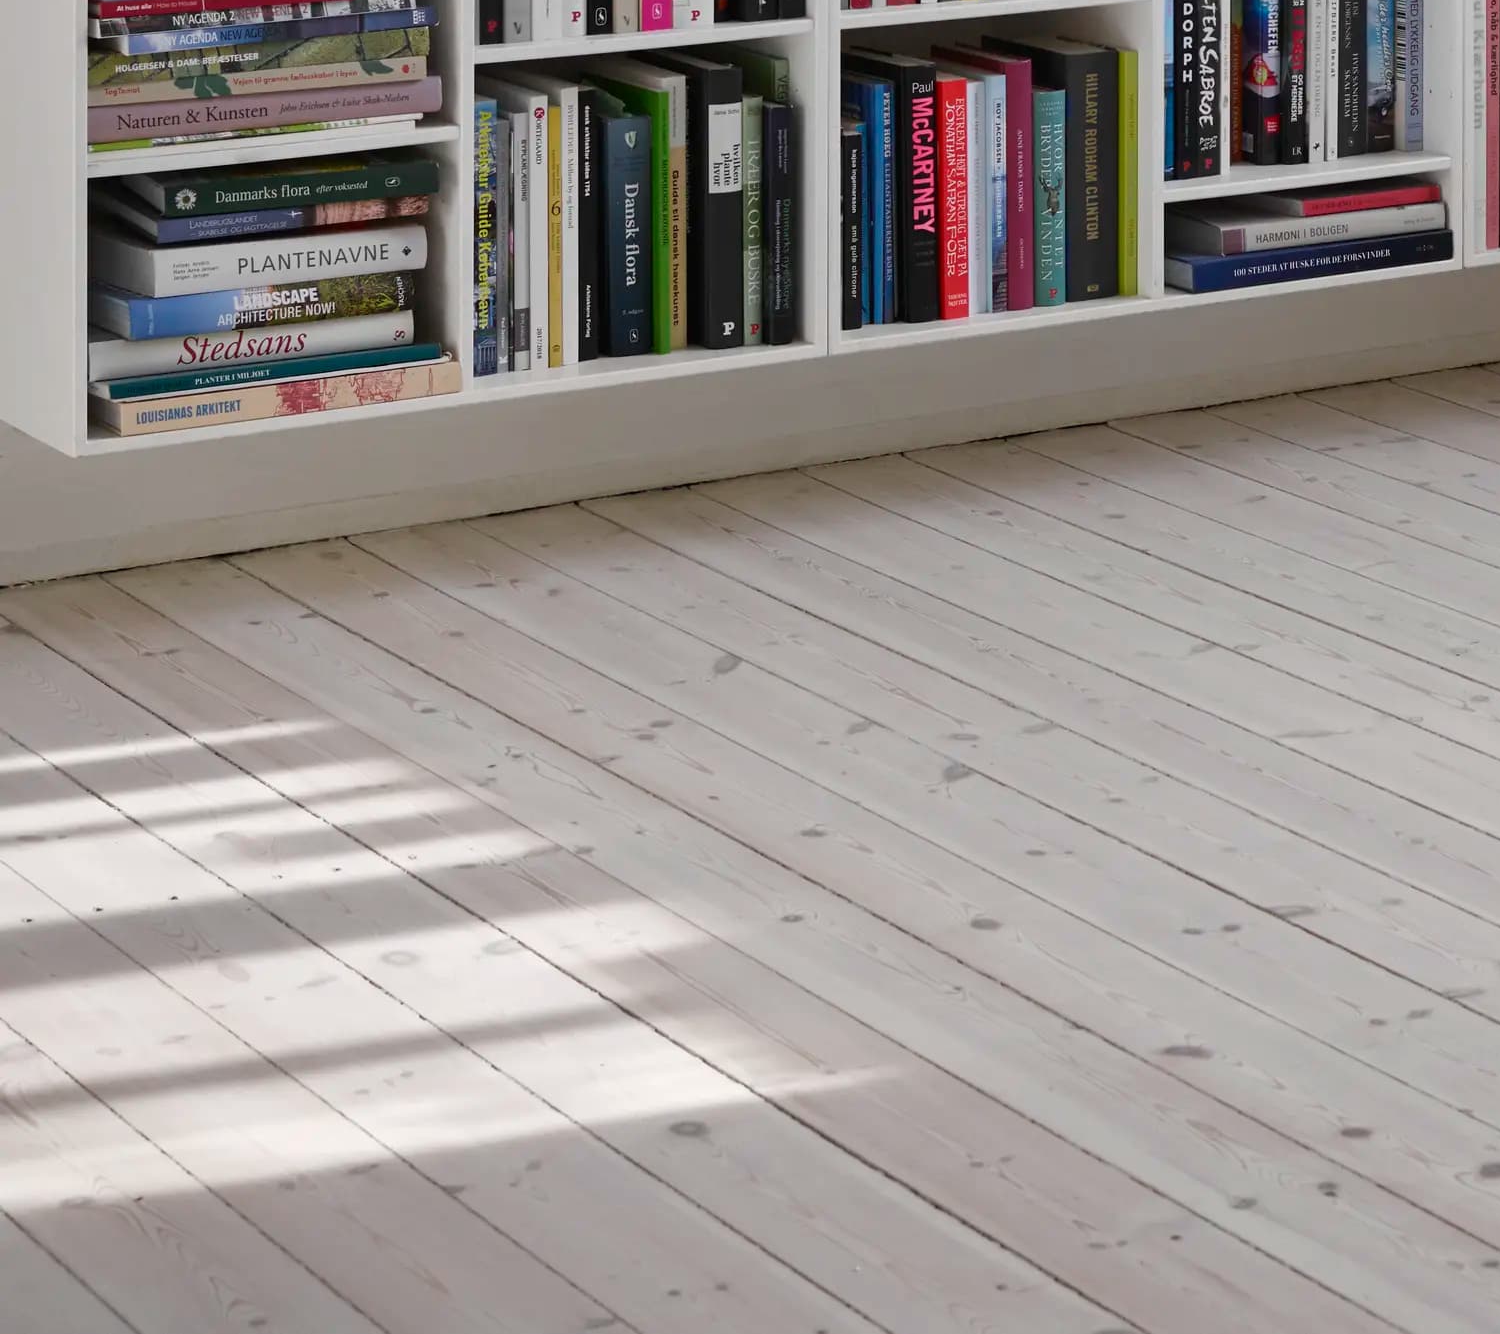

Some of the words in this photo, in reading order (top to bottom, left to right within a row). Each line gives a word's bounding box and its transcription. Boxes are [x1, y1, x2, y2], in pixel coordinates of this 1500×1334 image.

[1410, 20, 1419, 66] LYKKELIG
[912, 83, 934, 93] Paul
[1086, 73, 1098, 125] HILLARY
[1199, 46, 1216, 127] SABROE
[1410, 68, 1419, 115] UDGANG
[118, 113, 182, 130] Naturen
[186, 110, 200, 123] &
[206, 105, 268, 121] Kunsten
[478, 112, 491, 188] Arkitektur
[912, 97, 934, 233] McCARTNEY
[1085, 129, 1098, 182] RODHAM
[713, 162, 722, 187] hvor
[722, 153, 732, 186] plante
[216, 189, 277, 204] Danmarks
[282, 184, 310, 199] flora
[316, 184, 332, 195] efter
[335, 181, 368, 191] voksested
[625, 183, 639, 238] Dansk
[478, 193, 492, 238] Guide
[1086, 187, 1098, 240] CLINTON
[1256, 230, 1300, 243] HARMONI
[1304, 230, 1306, 238] I
[1310, 224, 1348, 237] BOLIGEN
[238, 244, 389, 274] PLANTENAVNE
[625, 244, 639, 286] flora
[1234, 268, 1246, 277] 100
[1248, 264, 1277, 275] STEDER
[1280, 264, 1288, 272] AT
[1290, 260, 1315, 270] HUSKE
[1316, 257, 1330, 266] FOR
[1332, 256, 1342, 264] DE
[1343, 249, 1390, 264] FORSVINDER
[233, 288, 318, 310] LANDSCAPE
[478, 243, 492, 328] København
[218, 307, 302, 326] ARCHITECTURE
[306, 302, 335, 316] NOW!
[177, 331, 307, 365] Stedsans
[136, 406, 192, 425] LOUISIANAS
[195, 400, 240, 415] ARKITEKT
